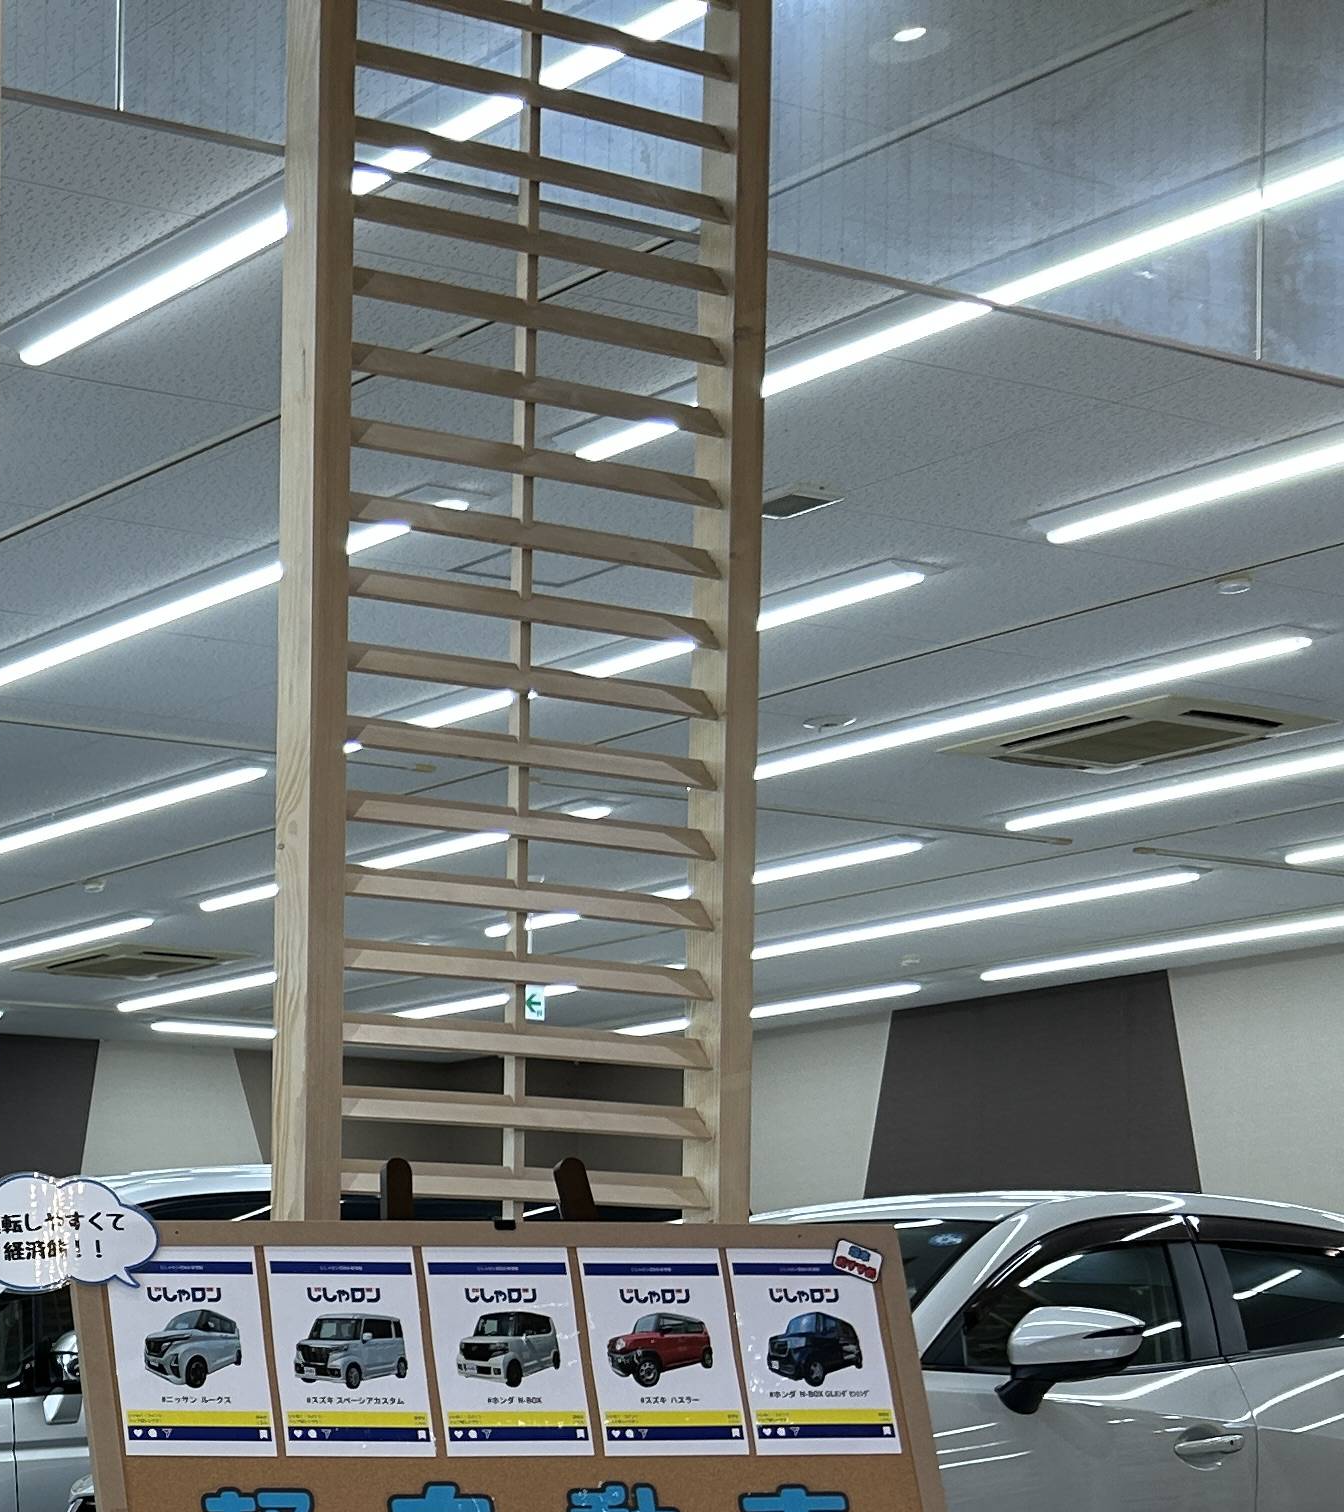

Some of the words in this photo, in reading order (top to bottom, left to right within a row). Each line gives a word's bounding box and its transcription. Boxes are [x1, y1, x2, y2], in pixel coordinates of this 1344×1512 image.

[146, 1287, 221, 1303] じしゃロン
[307, 1287, 381, 1303] じしゃロン
[465, 1287, 537, 1303] じしゃロン
[619, 1288, 690, 1304] じしゃロン
[769, 1288, 839, 1303] じしゃロン
